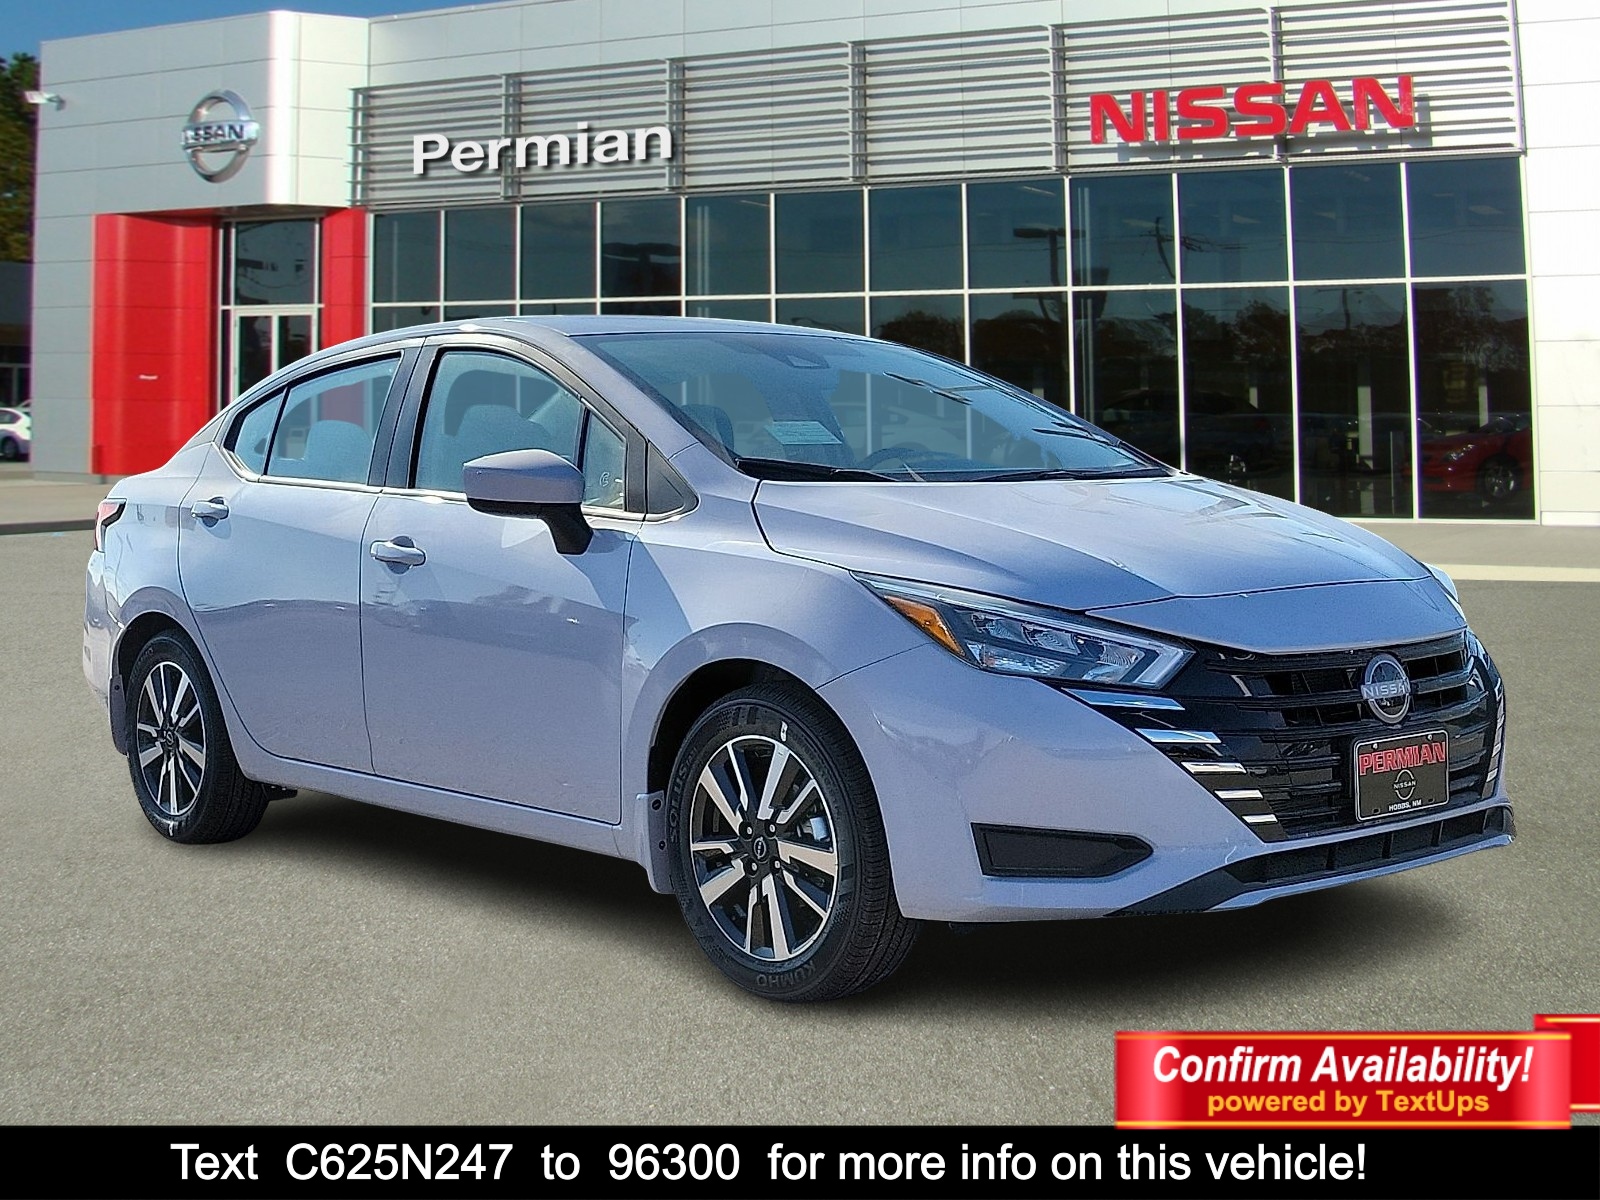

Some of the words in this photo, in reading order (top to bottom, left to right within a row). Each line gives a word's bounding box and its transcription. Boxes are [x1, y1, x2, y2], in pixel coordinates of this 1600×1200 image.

[1090, 74, 1415, 144] NISSAN
[181, 123, 245, 144] SSAN
[413, 121, 672, 175] Permian
[1363, 681, 1411, 699] NISSAN
[1359, 742, 1446, 775] PERMIAN
[1393, 780, 1416, 789] NISSAN
[1412, 799, 1422, 807] NM
